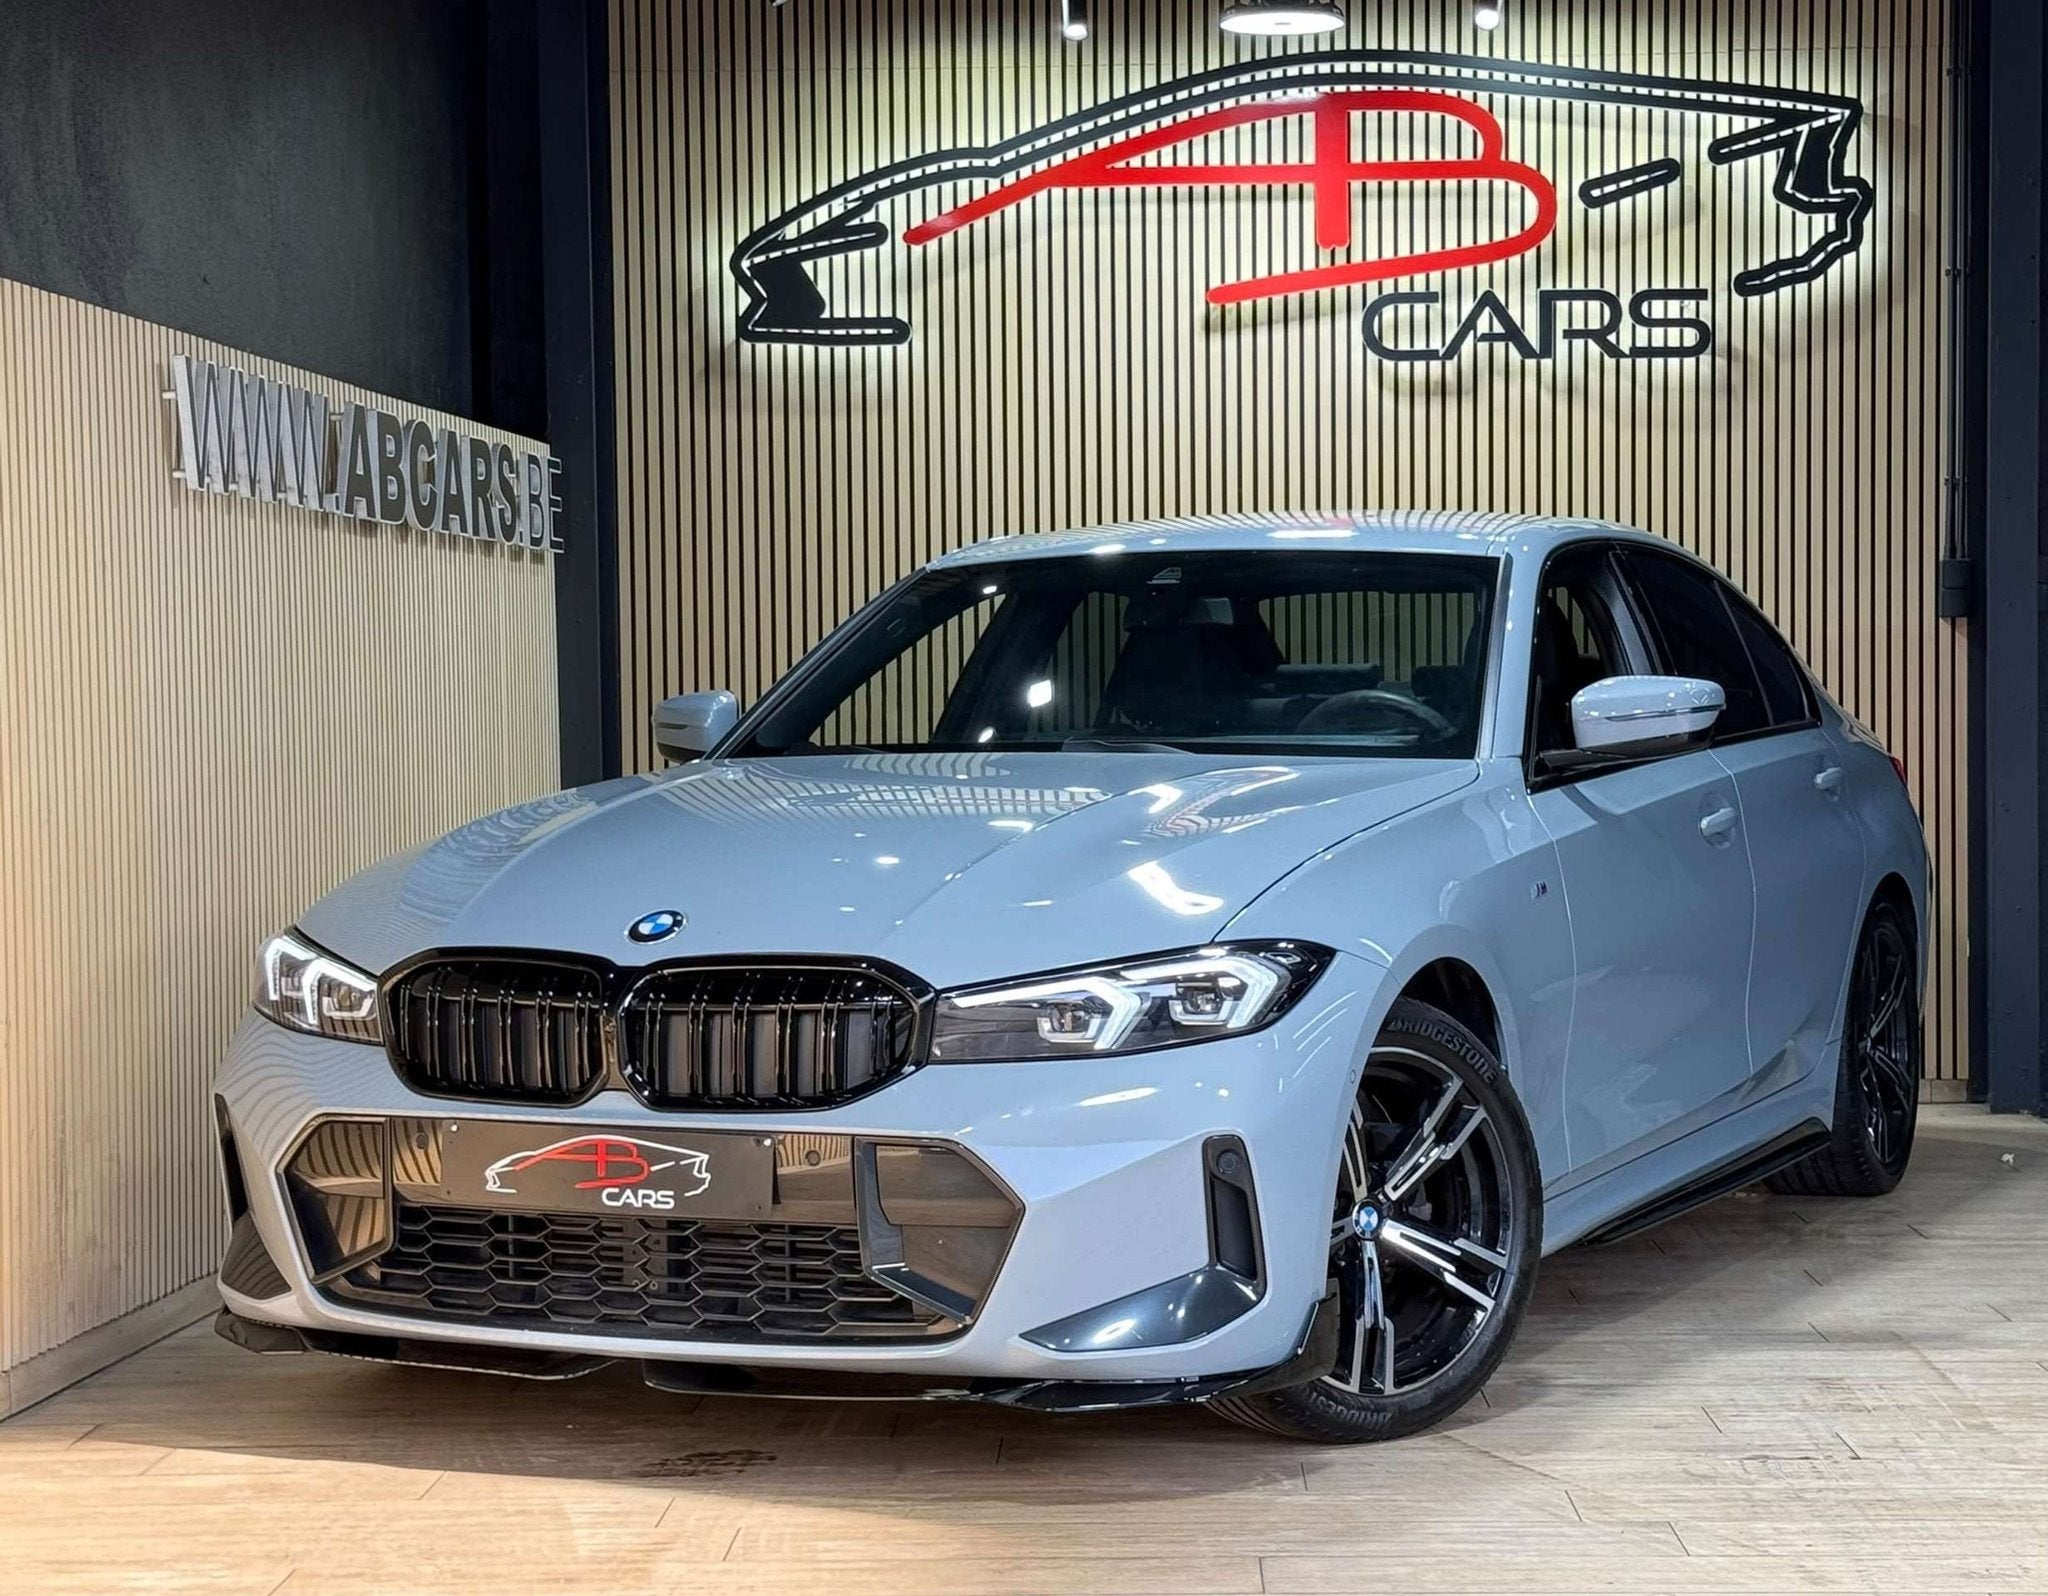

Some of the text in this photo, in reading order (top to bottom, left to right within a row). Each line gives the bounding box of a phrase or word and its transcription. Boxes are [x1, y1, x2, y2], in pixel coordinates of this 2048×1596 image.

[1362, 287, 1712, 361] CARS
[173, 354, 564, 553] WWW.ABCARS.BE
[1387, 1018, 1497, 1084] BRIDGESTONE
[601, 1187, 675, 1209] CARS
